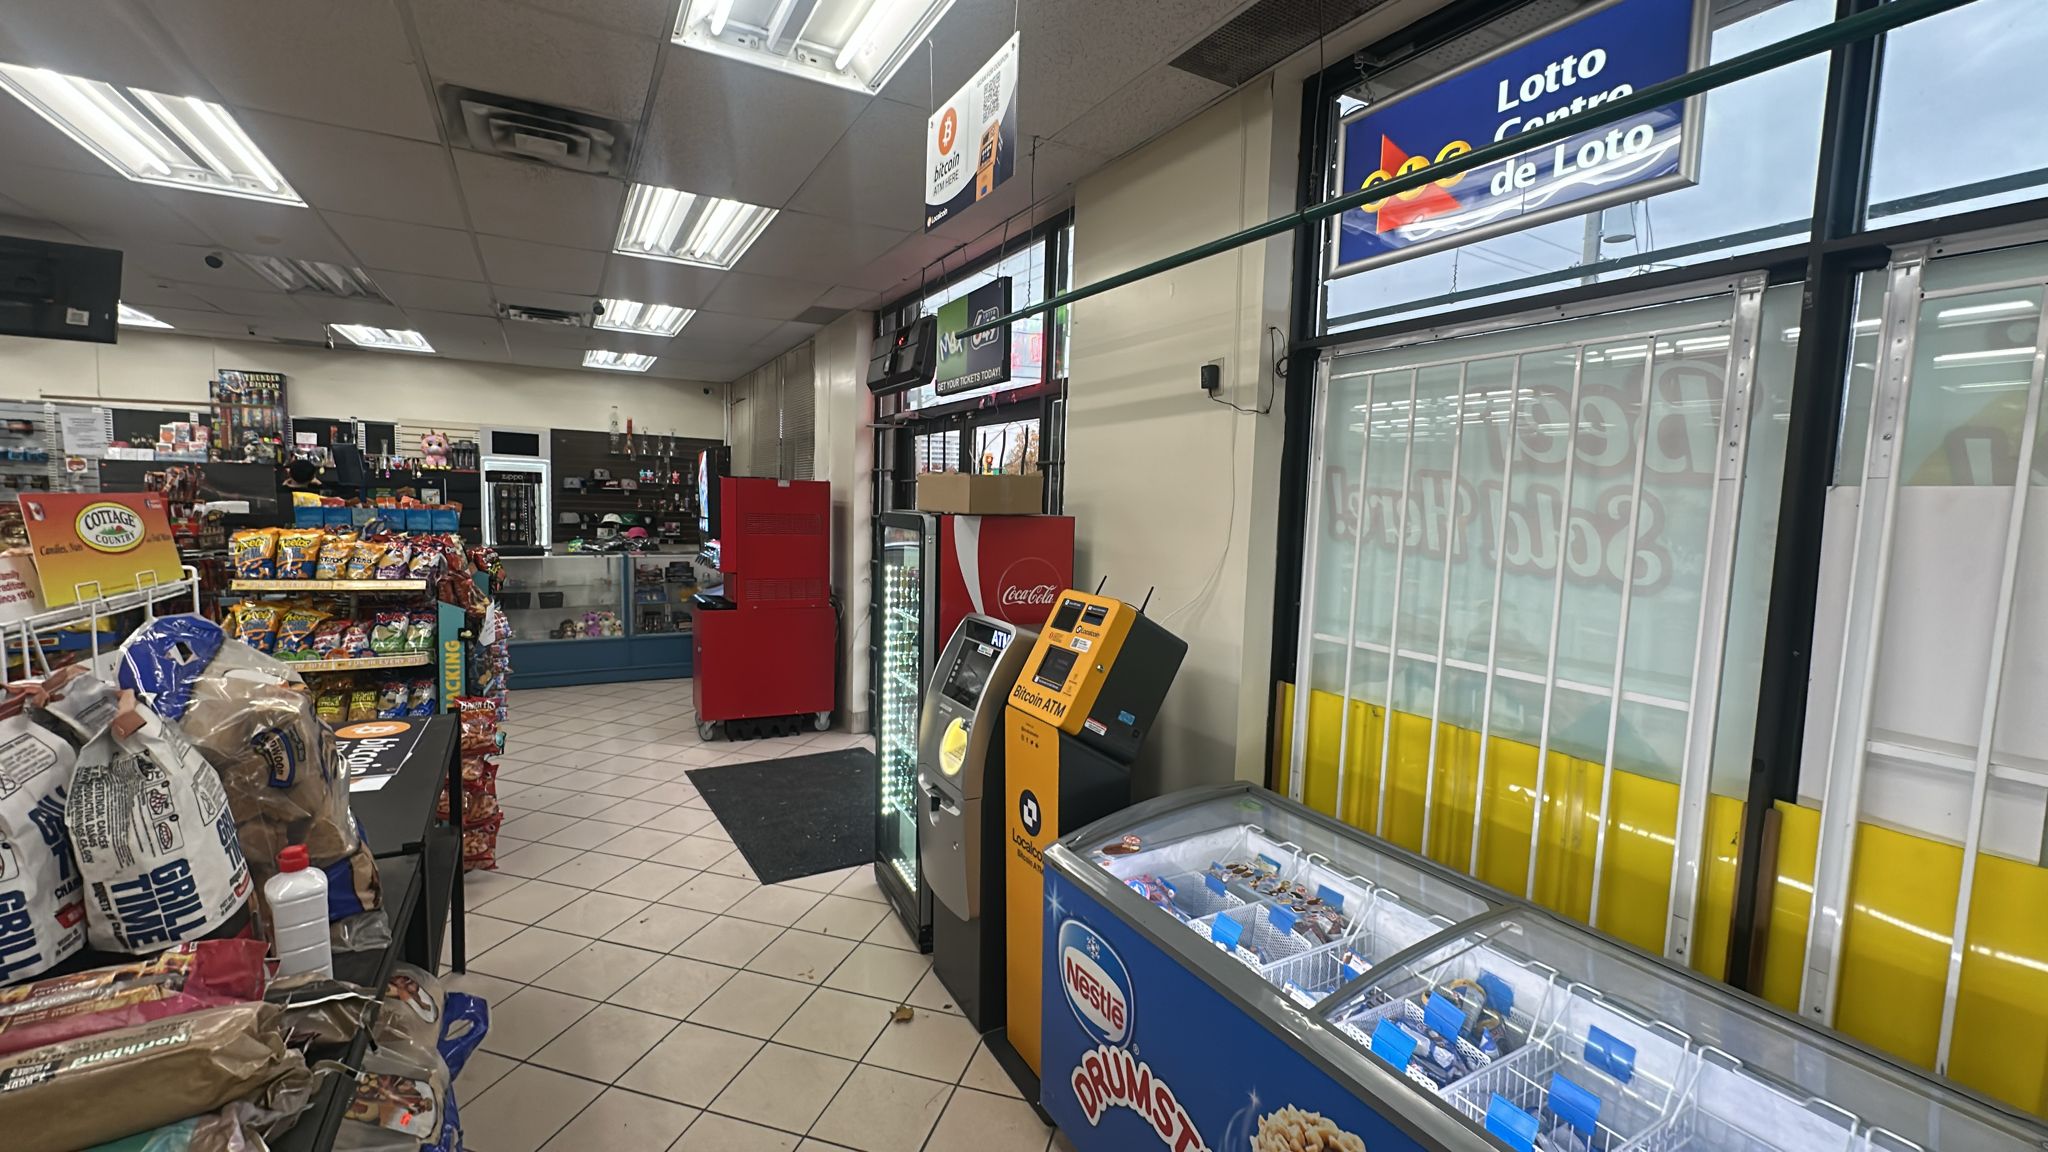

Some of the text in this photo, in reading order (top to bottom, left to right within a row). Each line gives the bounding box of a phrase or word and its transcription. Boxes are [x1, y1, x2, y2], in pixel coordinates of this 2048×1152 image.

[1497, 48, 1607, 113] Lotto
[934, 151, 960, 183] bitcoin
[1490, 124, 1654, 196] de Loto
[933, 169, 960, 197] ATM HERE
[937, 381, 946, 392] GET
[946, 377, 960, 391] YOUR
[960, 372, 981, 387] TICKETS
[84, 510, 136, 530] COTTAGE
[95, 531, 136, 545] COUNTRY
[1013, 684, 1067, 719] Bitcoin ATM
[1012, 827, 1045, 864] Localco
[110, 873, 169, 949] TIME
[150, 858, 208, 942] GRILL
[68, 1034, 188, 1069] Northland
[1073, 1050, 1203, 1152] DRUMST
